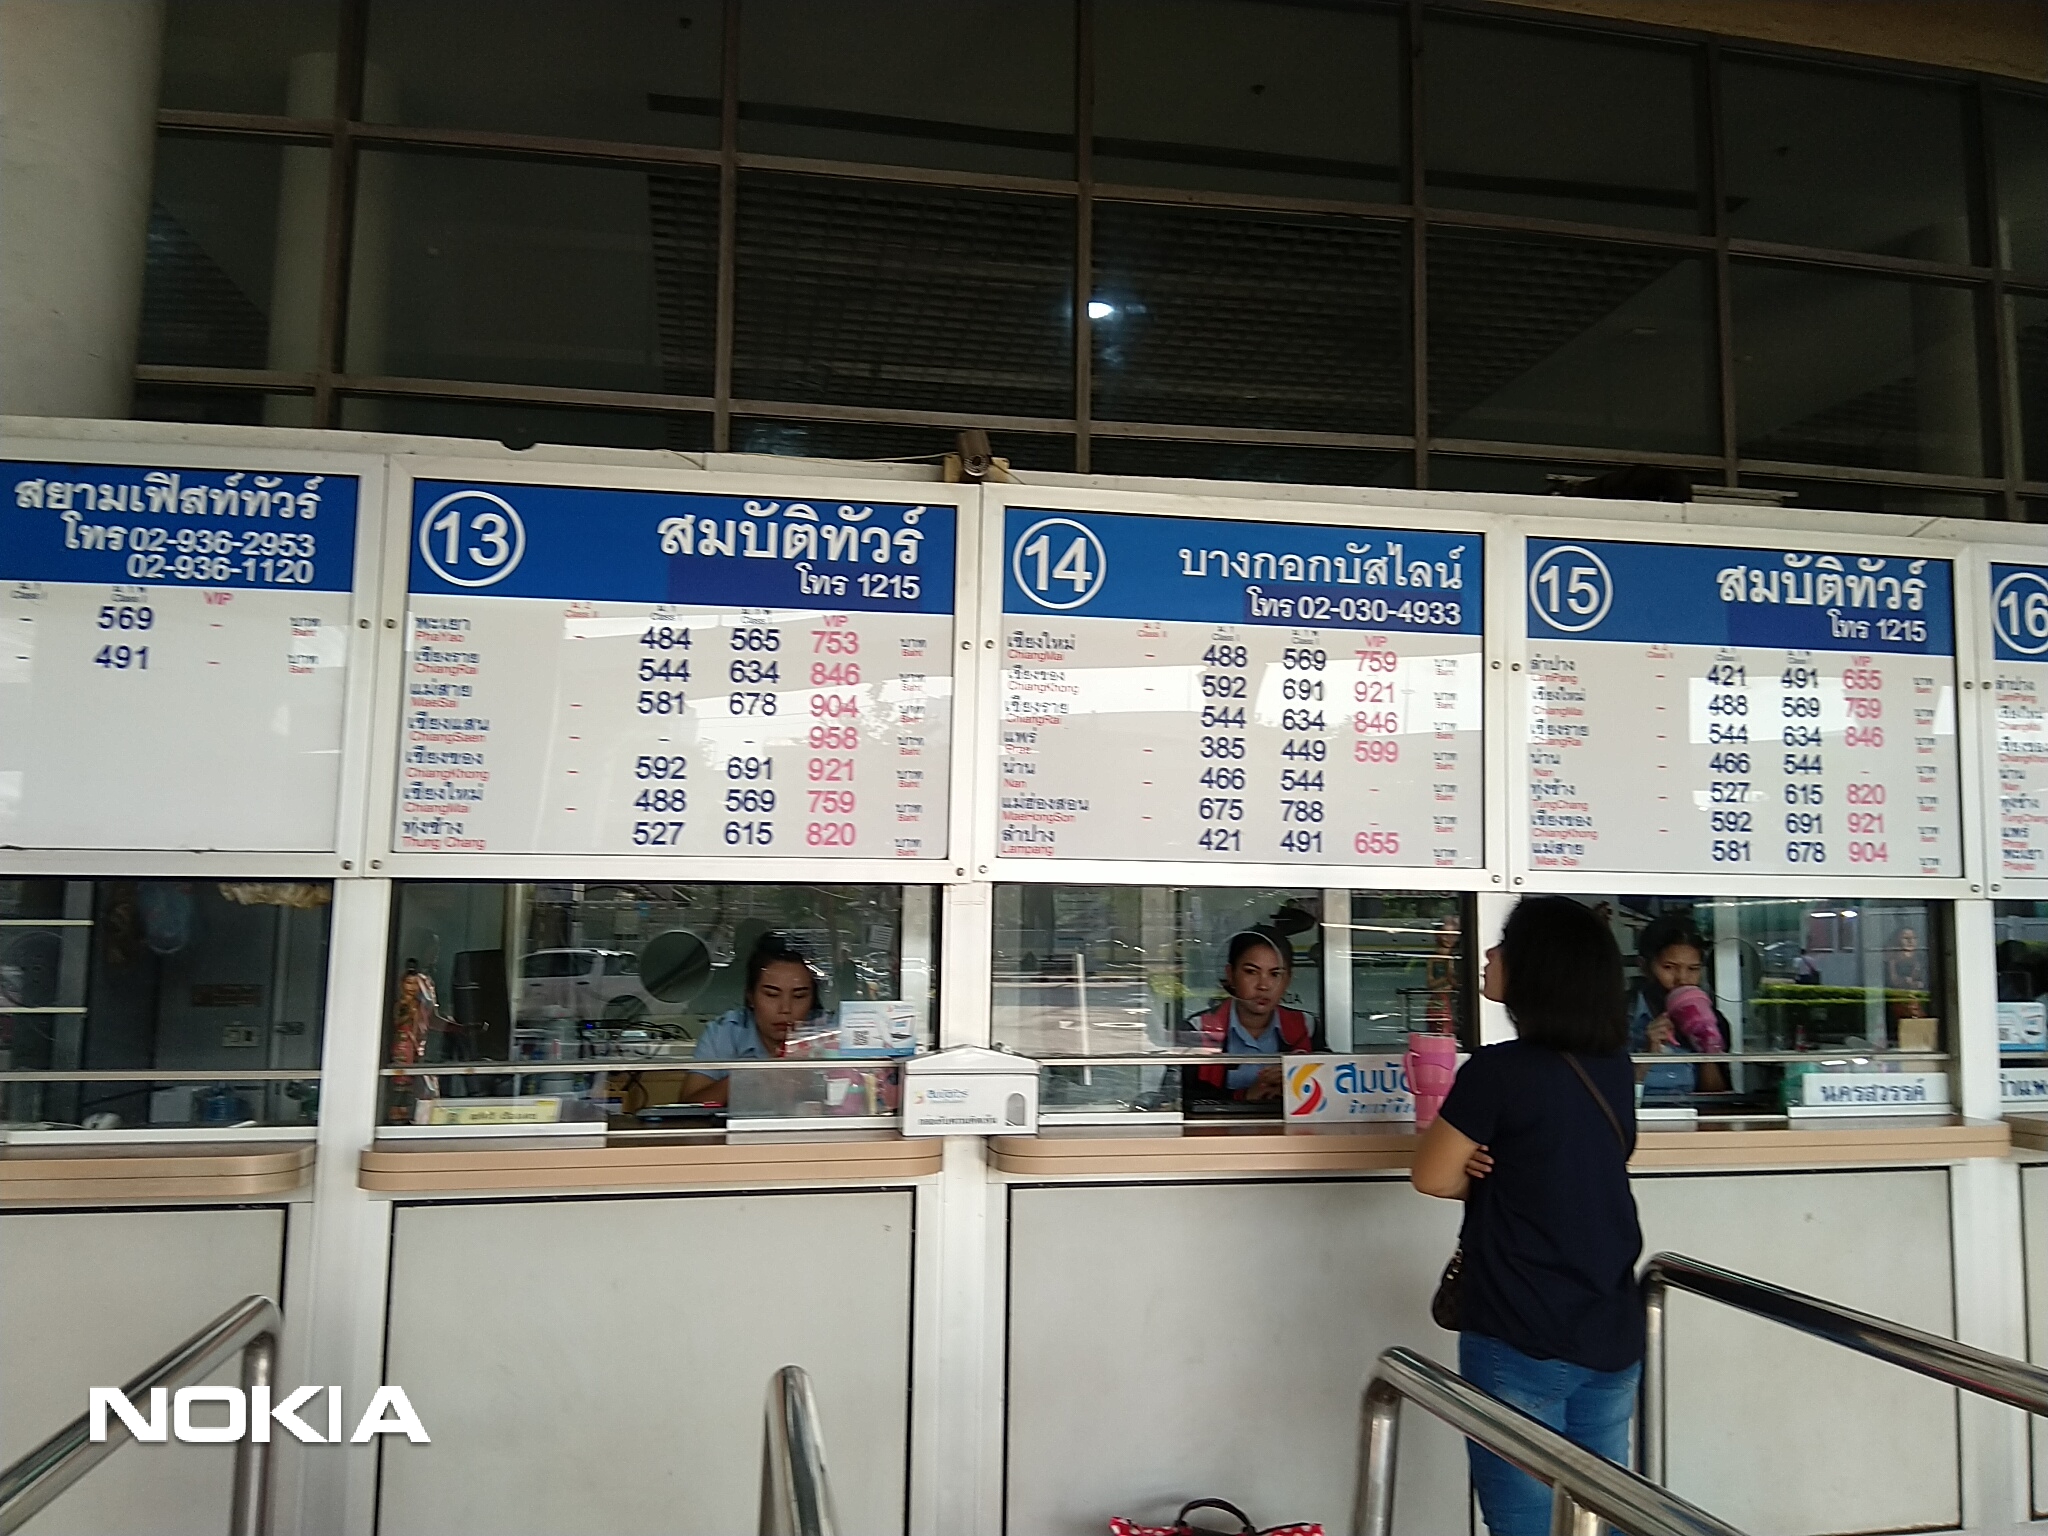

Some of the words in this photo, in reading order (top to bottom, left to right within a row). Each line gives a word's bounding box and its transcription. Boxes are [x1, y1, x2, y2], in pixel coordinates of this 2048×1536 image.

[60, 511, 127, 551] โทร
[129, 528, 316, 558] 02-936-2953
[434, 510, 511, 566] 13
[656, 500, 927, 565] สมบัติทัวร์
[127, 554, 315, 585] 02-936-1120
[1024, 535, 1093, 593] 14
[1178, 541, 1465, 590] บางกอกบัสไลน์
[795, 561, 849, 597] โทร
[857, 573, 922, 600] 1215
[1539, 565, 1600, 615] 15
[1716, 553, 1928, 611] สมบัติทัวร์
[96, 606, 154, 631] 569
[1246, 586, 1295, 618] โทร
[1297, 596, 1462, 625] 02-030-4933
[2000, 591, 2048, 638] 16
[823, 614, 850, 627] VIP
[1827, 608, 1869, 640] โทร
[1876, 616, 1927, 643] 1215
[639, 627, 692, 650] 484
[730, 628, 780, 651] 565
[810, 631, 860, 654] 753
[1364, 635, 1388, 647] VIP
[93, 644, 150, 670] 491
[1202, 645, 1248, 668] 488
[1283, 649, 1327, 671] 569
[1355, 650, 1398, 673] 759
[637, 659, 692, 682] 544
[729, 660, 780, 684] 634
[810, 662, 861, 686] 846
[1707, 665, 1747, 686] 421
[1780, 668, 1819, 689] 491
[1843, 669, 1882, 690] 655
[1202, 675, 1247, 699] 592
[1282, 678, 1325, 701] 691
[1354, 680, 1395, 703] 921
[637, 691, 686, 715] 581
[729, 692, 777, 716] 678
[810, 694, 860, 718] 904
[1708, 695, 1748, 716] 488
[1782, 697, 1820, 718] 569
[1844, 698, 1882, 719] 759
[1200, 706, 1247, 729] 544
[1282, 709, 1326, 732] 634
[1354, 711, 1398, 734] 846
[809, 726, 858, 750] 958
[1709, 724, 1748, 744] 544
[1783, 726, 1822, 747] 634
[1844, 726, 1883, 747] 846
[1200, 736, 1246, 759] 385
[1280, 739, 1327, 762] 449
[1354, 740, 1399, 763] 599
[634, 756, 687, 780] 592
[727, 757, 773, 780] 691
[808, 758, 855, 781] 921
[1709, 753, 1750, 773] 466
[1783, 754, 1823, 775] 544
[1198, 767, 1246, 790] 466
[1280, 769, 1325, 792] 544
[633, 789, 687, 813] 488
[725, 789, 775, 813] 569
[807, 790, 856, 814] 759
[1711, 782, 1751, 803] 527
[1785, 784, 1824, 805] 615
[1847, 784, 1886, 805] 820
[1199, 798, 1244, 821] 675
[1280, 800, 1324, 823] 788
[1711, 811, 1753, 832] 592
[1785, 813, 1823, 834] 691
[1848, 813, 1884, 834] 921
[632, 822, 686, 845] 527
[724, 821, 774, 845] 615
[806, 822, 856, 846] 820
[1198, 828, 1241, 851] 421
[1280, 830, 1322, 853] 491
[1354, 832, 1399, 855] 655
[1712, 840, 1751, 861] 581
[1787, 842, 1825, 863] 678
[1849, 842, 1888, 863] 904
[1820, 1077, 1927, 1102] นครสวรรค์
